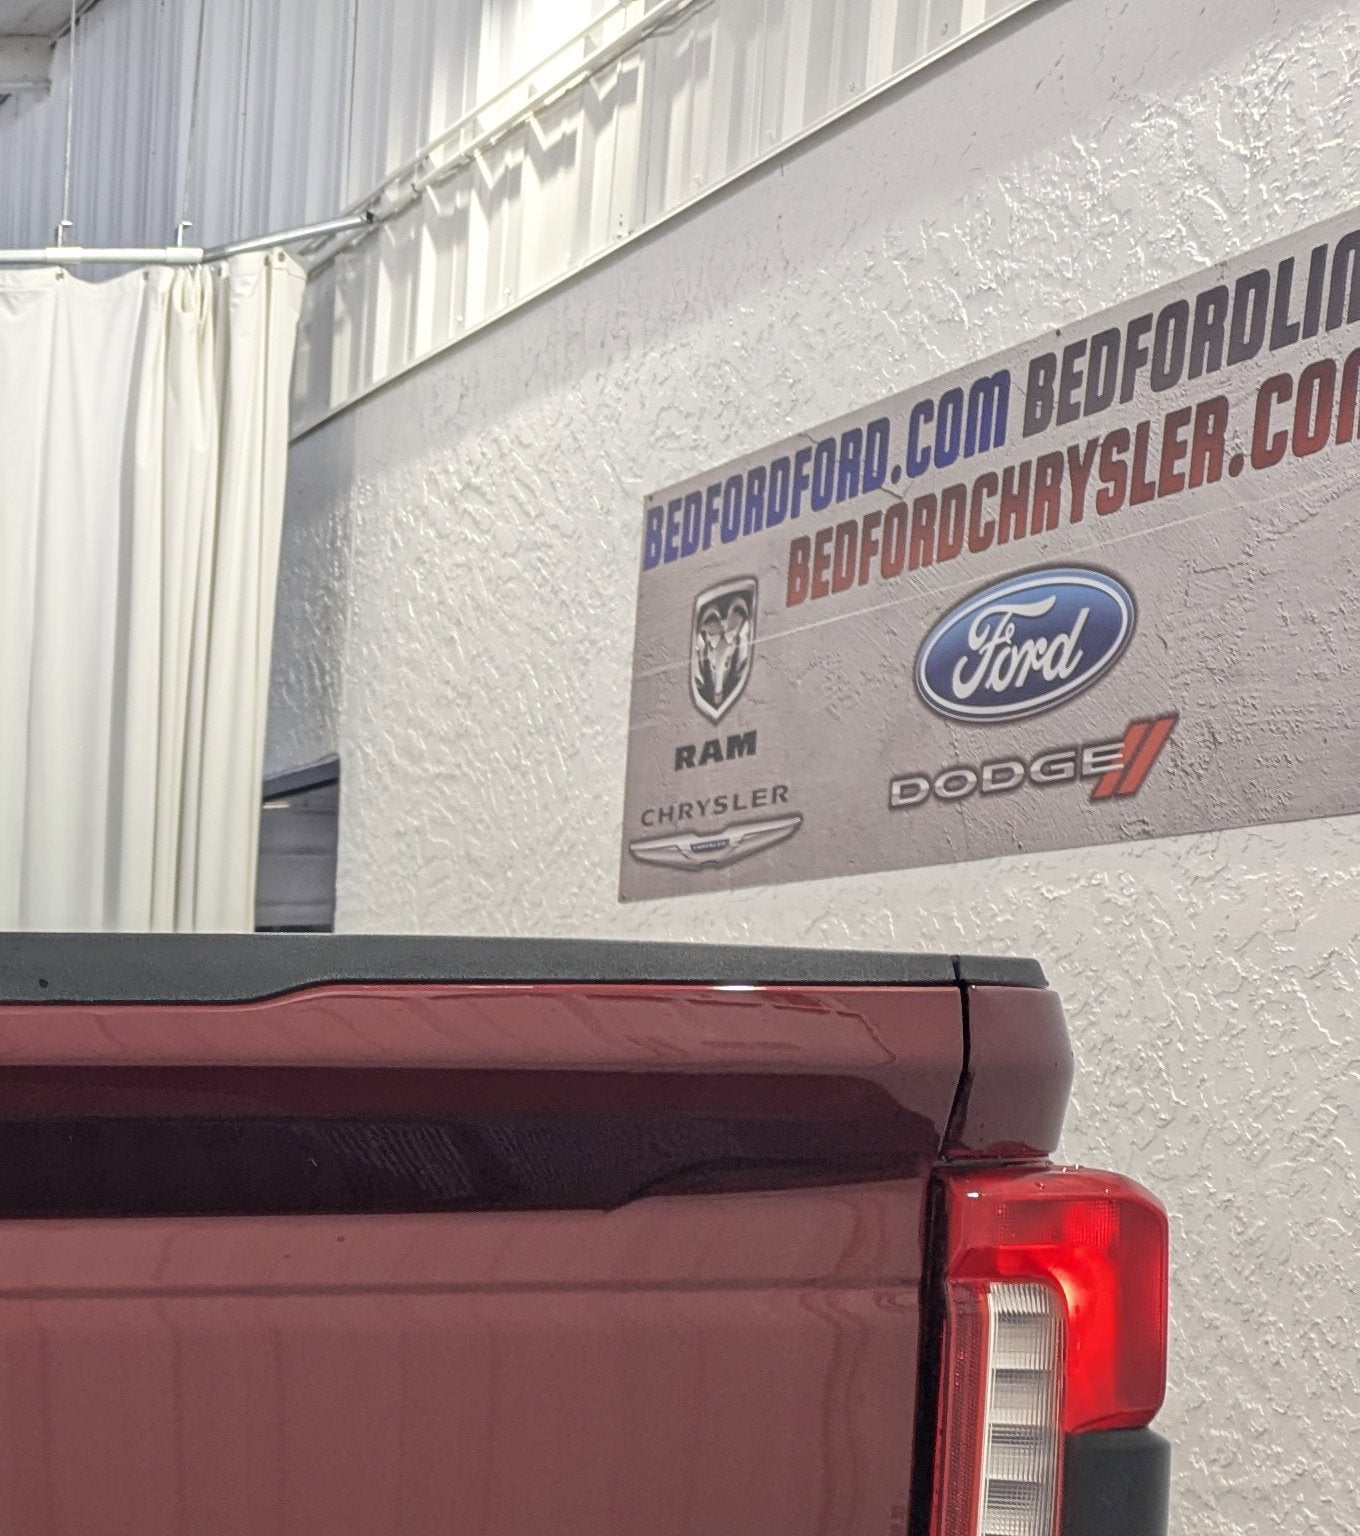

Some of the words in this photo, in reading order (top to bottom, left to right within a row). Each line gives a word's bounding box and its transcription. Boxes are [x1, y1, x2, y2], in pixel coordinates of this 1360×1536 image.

[642, 368, 1011, 572] BEDFORDFORD.COM
[952, 595, 1090, 700] Ford
[674, 729, 758, 772] RAM
[889, 742, 1126, 806] DODGE
[640, 784, 789, 827] CHRYSLER
